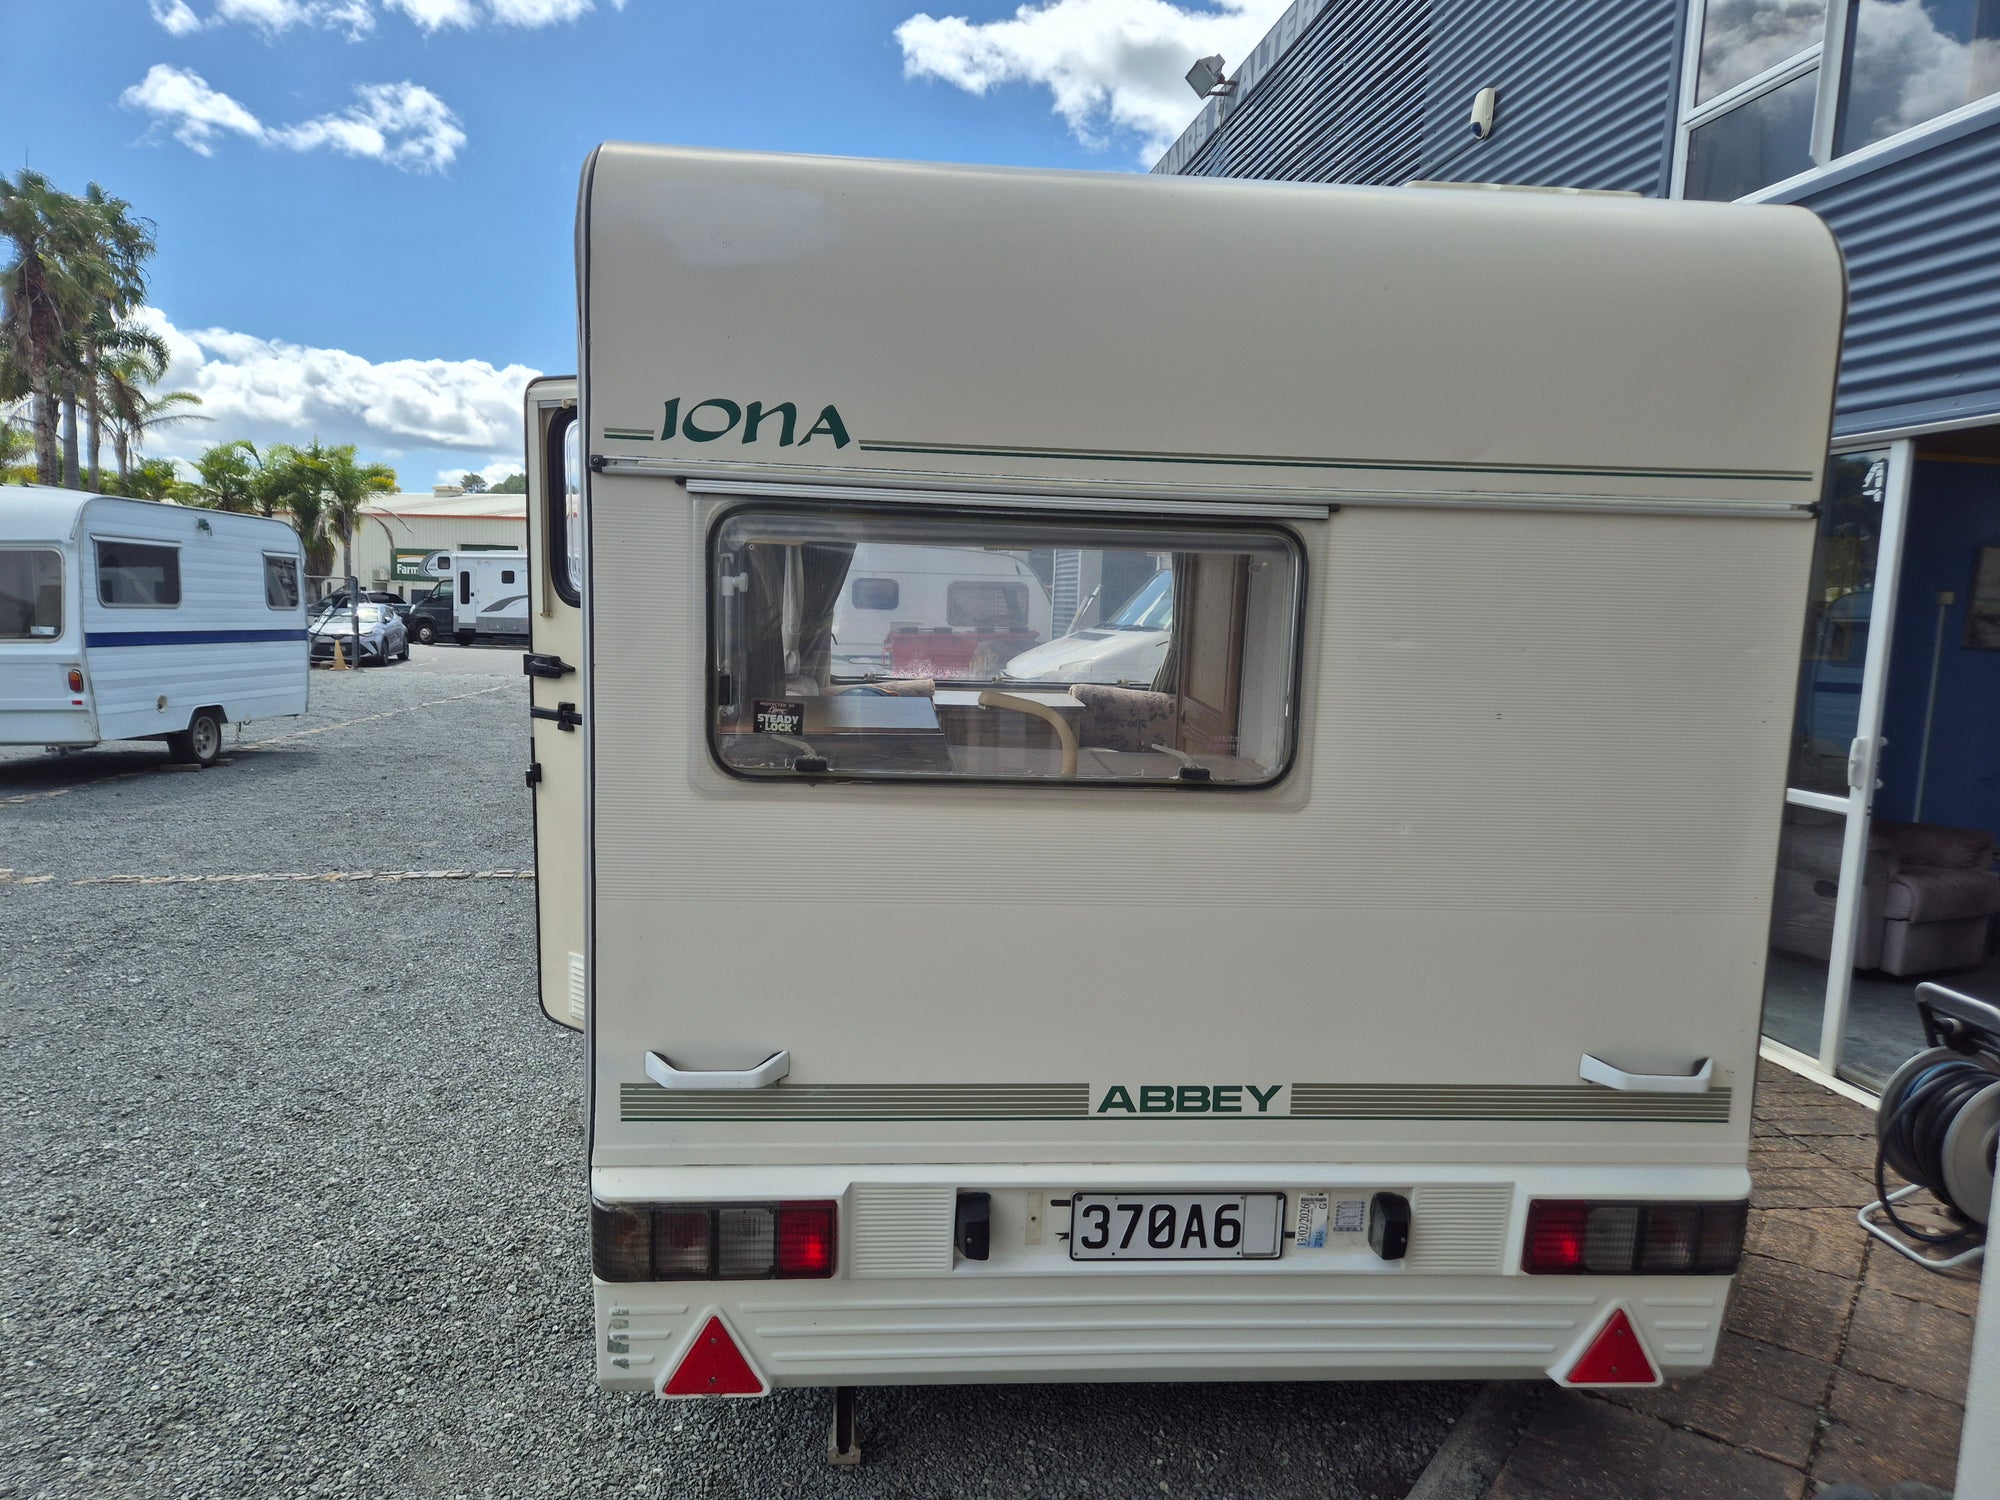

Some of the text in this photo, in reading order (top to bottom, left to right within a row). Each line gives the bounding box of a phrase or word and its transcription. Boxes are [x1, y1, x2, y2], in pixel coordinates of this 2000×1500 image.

[1235, 0, 1326, 105] ALTER
[660, 397, 850, 449] IONA
[757, 713, 799, 725] STEADY
[764, 722, 792, 732] LOCK
[1097, 1085, 1283, 1113] ABBEY
[1081, 1204, 1241, 1249] 370A6
[1296, 1203, 1311, 1246] 13/02/2026
